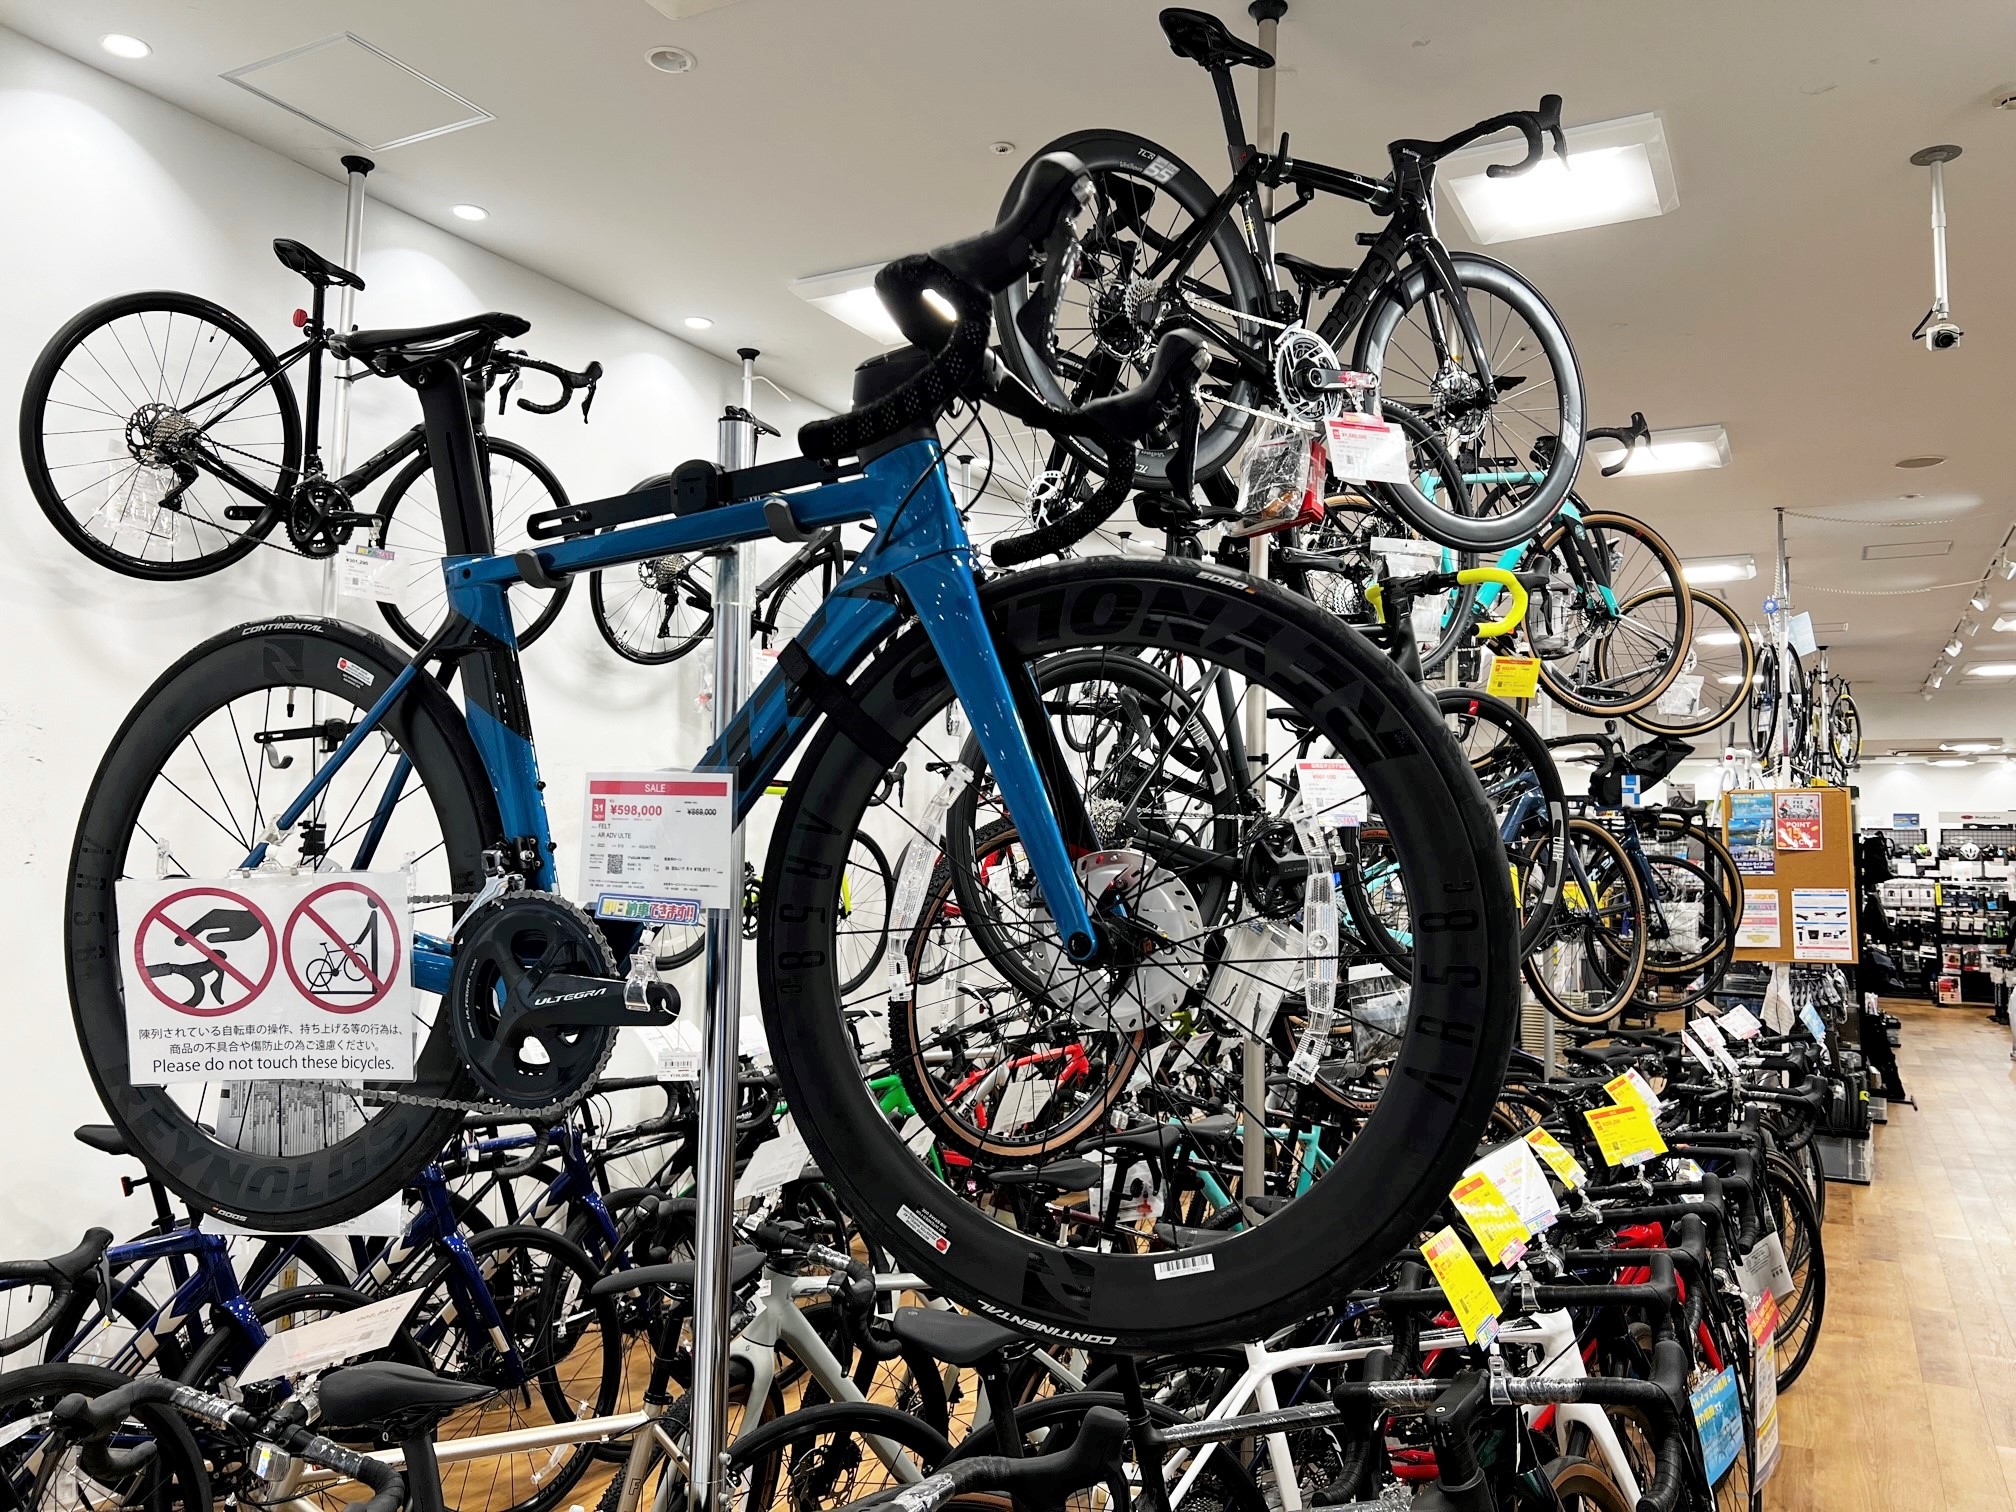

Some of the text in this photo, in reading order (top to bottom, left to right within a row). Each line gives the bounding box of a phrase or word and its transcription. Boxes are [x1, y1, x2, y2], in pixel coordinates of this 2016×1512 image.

[1120, 161, 1143, 171] Vision
[1142, 162, 1173, 184] 55
[1195, 573, 1248, 589] 5000
[241, 622, 324, 636] CONTINENTAL
[892, 579, 1419, 763] REYNOLS
[644, 784, 667, 793] SALE
[594, 803, 604, 812] 31
[610, 804, 662, 817] ¥598,000
[534, 987, 607, 1006] ULTEGRA
[138, 1023, 403, 1040] 陳列されている自転車の操作、持ち上げる等の行為は、
[169, 1039, 381, 1054] 商品の不具合や傷防止の為ご遠慮ください。
[153, 1055, 395, 1073] Please do not touch these bicycles.
[978, 1300, 1118, 1345] CONTINENTAL
